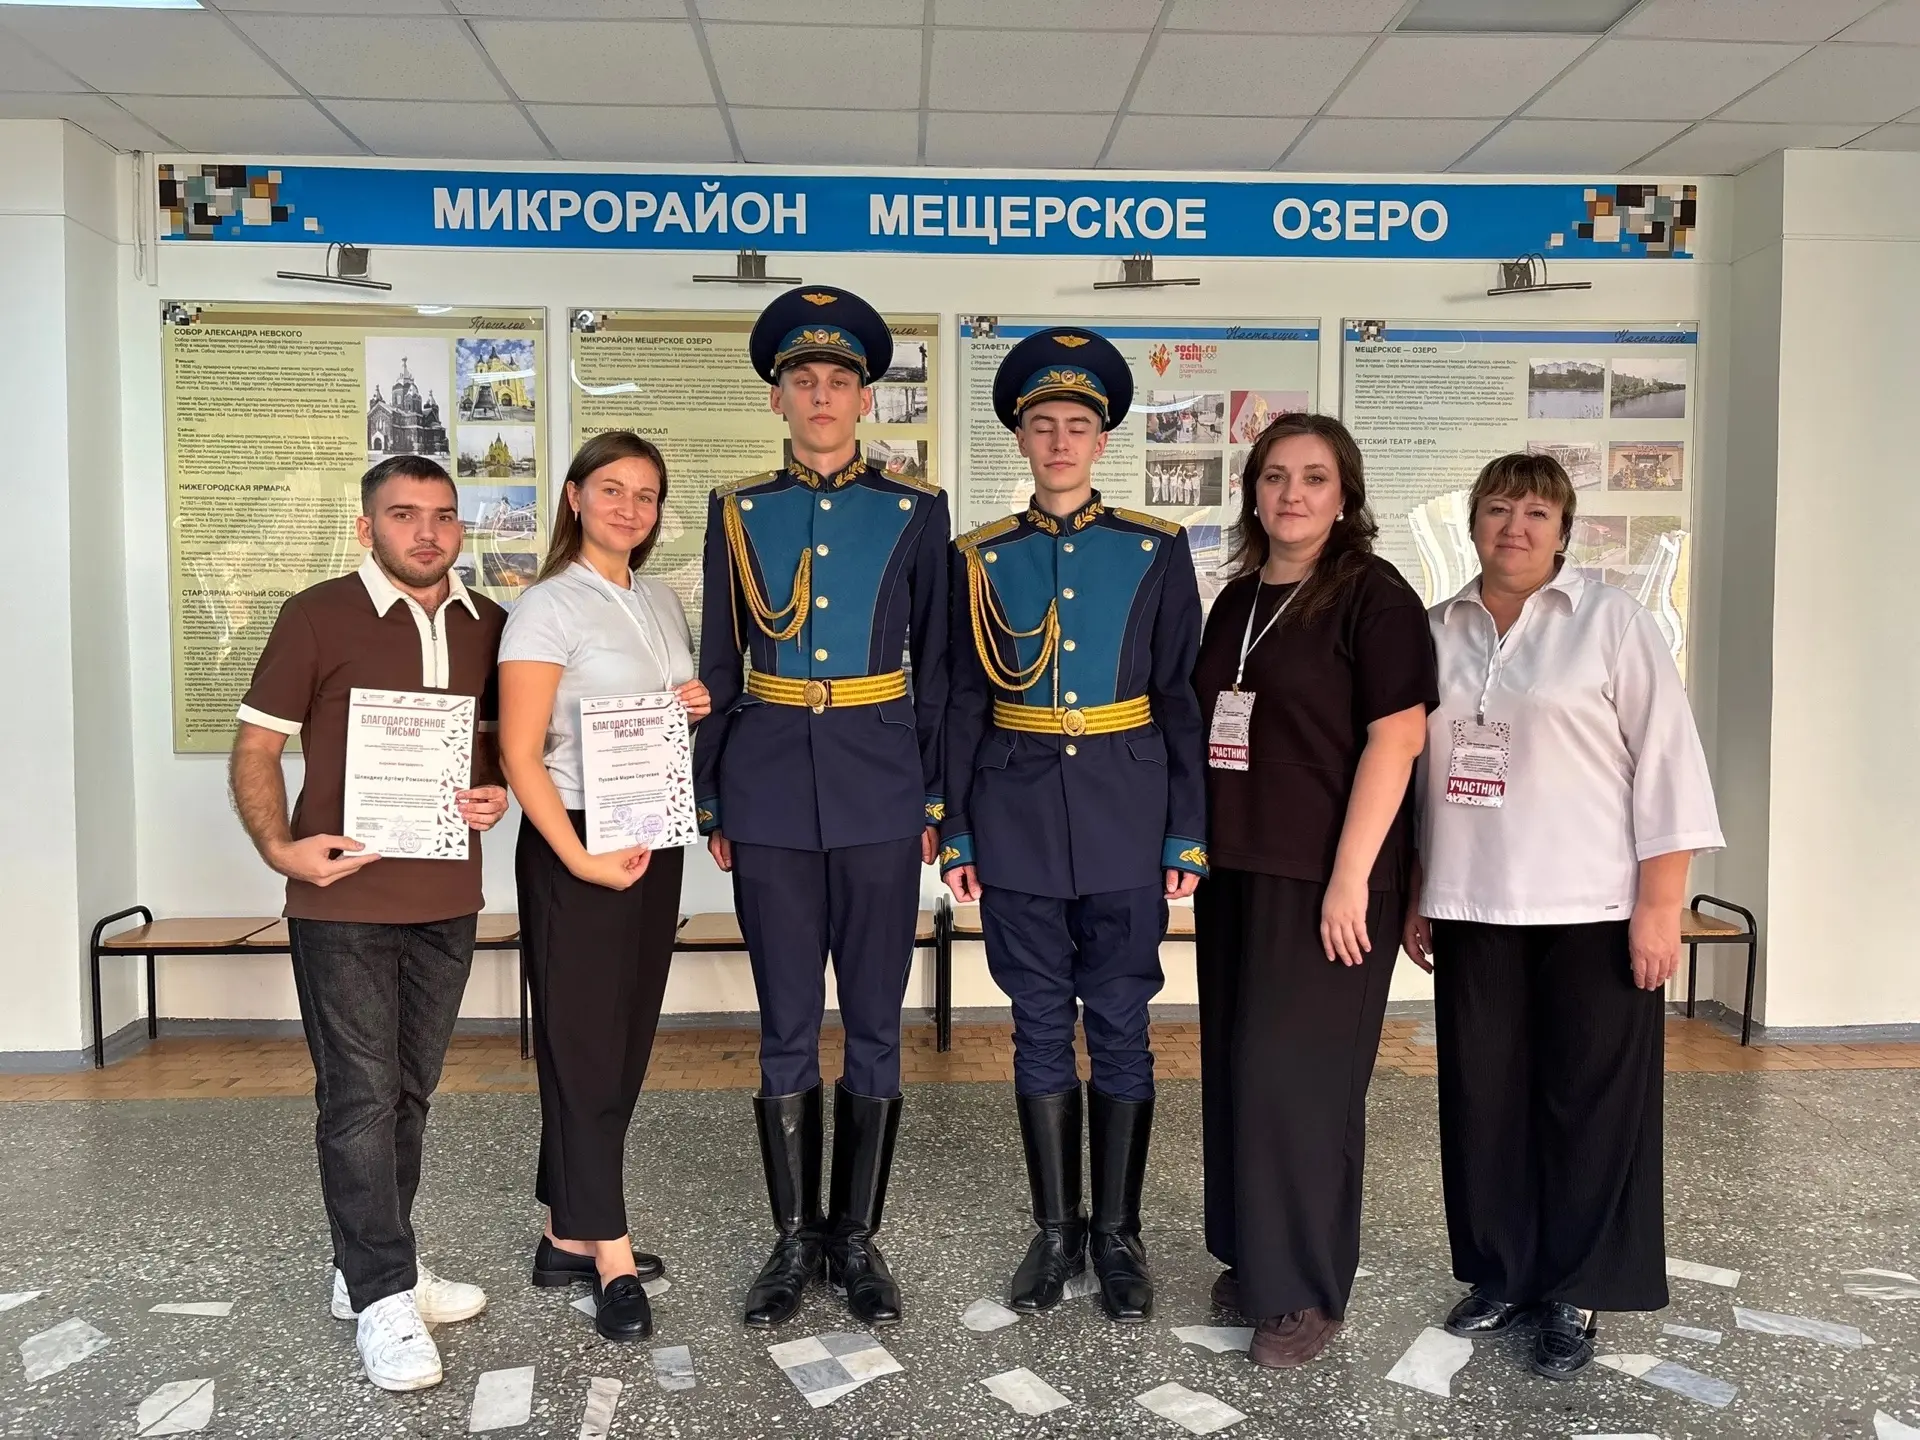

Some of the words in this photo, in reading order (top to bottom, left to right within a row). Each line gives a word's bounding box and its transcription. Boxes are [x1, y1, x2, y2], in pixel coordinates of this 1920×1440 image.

[433, 181, 807, 235] МИКРОРАЙОН
[869, 193, 1207, 245] МЕЩЕРСКОЕ
[1272, 198, 1449, 241] ОЗЕРО
[1174, 343, 1217, 353] sochi.ru
[1180, 354, 1202, 362] 2014
[361, 714, 446, 728] БЛАГОДАРСТВЕННОЕ
[592, 715, 664, 731] БЛАГОДАРСТВЕННОЕ
[385, 726, 421, 737] ПИСЬМО
[614, 728, 644, 739] ПИСЬМО
[1210, 746, 1247, 759] УЧАСТНИК
[1450, 779, 1502, 796] УЧАСТНИК
